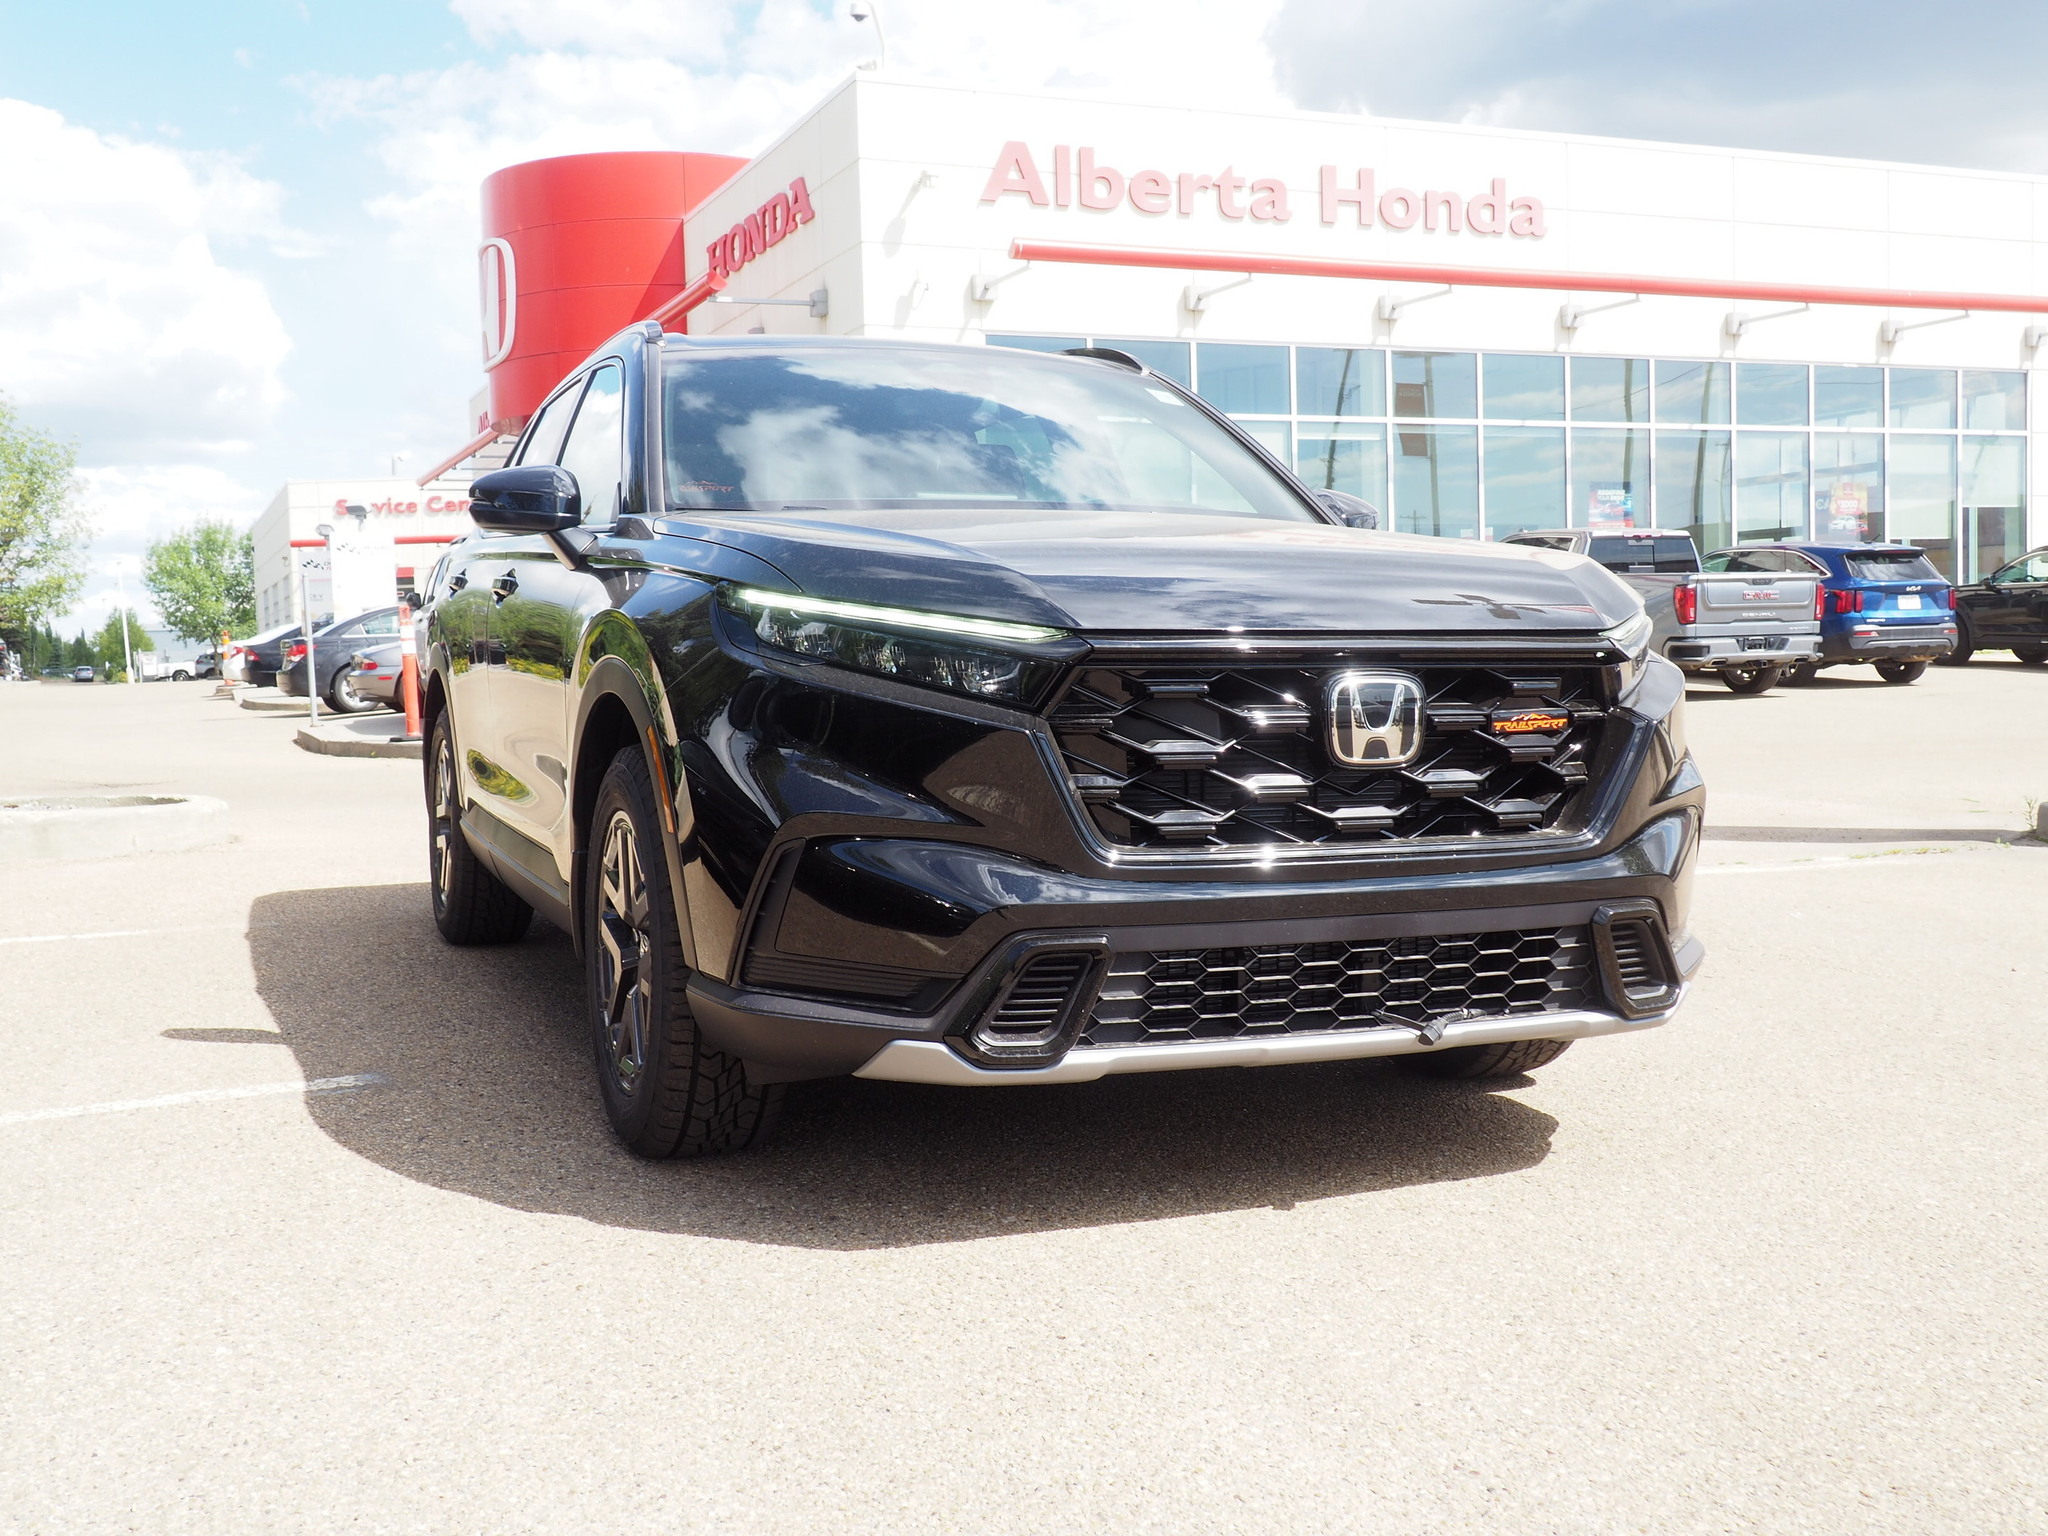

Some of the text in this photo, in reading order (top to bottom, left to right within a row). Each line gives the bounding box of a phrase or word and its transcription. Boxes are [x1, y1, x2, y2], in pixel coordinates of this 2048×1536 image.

[980, 140, 1547, 237] Alberta Honda
[706, 176, 816, 279] HONDA
[335, 498, 418, 515] Svice
[1742, 589, 1780, 600] GMC
[1493, 718, 1567, 731] TRAILSPORT
